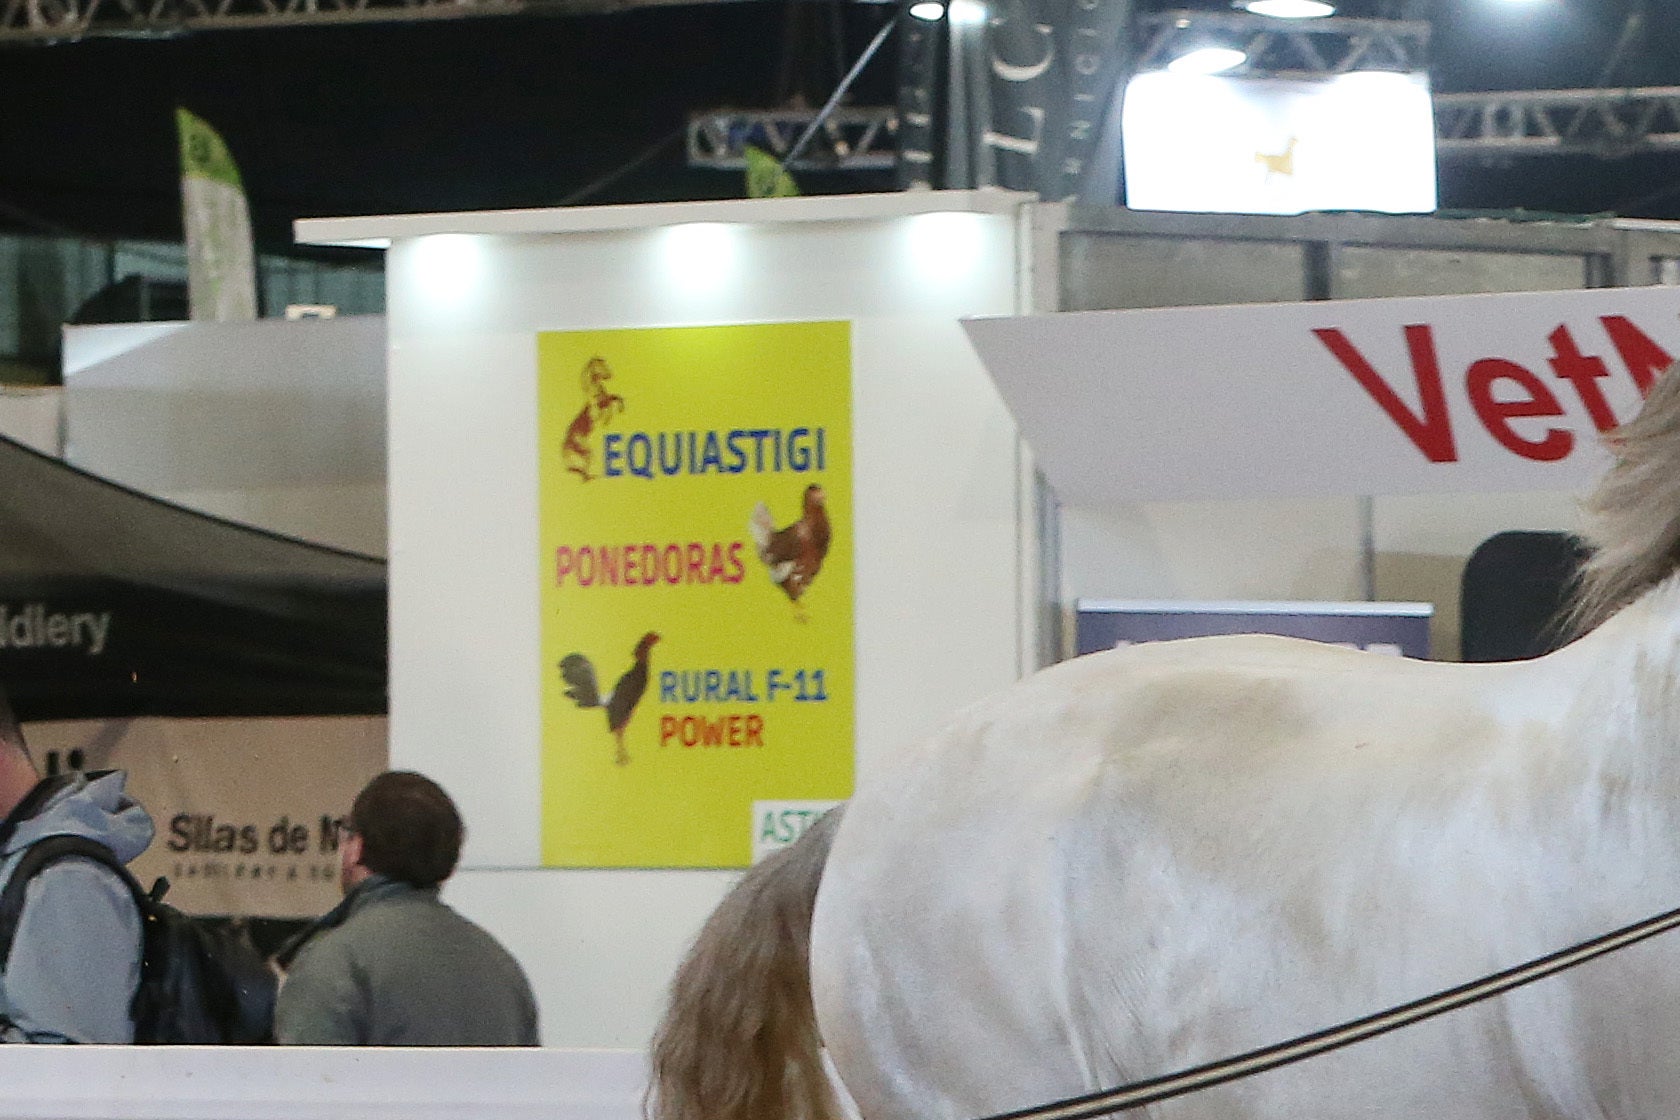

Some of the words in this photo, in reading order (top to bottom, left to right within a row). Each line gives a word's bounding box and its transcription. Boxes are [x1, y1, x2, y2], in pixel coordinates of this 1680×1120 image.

[603, 427, 827, 479] EQUIASTIGI
[555, 542, 746, 589] PONEDORAS
[0, 602, 111, 655] dlery
[660, 669, 758, 703] RURAL
[766, 668, 828, 703] F-11
[659, 713, 765, 749] POWER
[268, 815, 309, 855] de
[760, 809, 823, 844] AST
